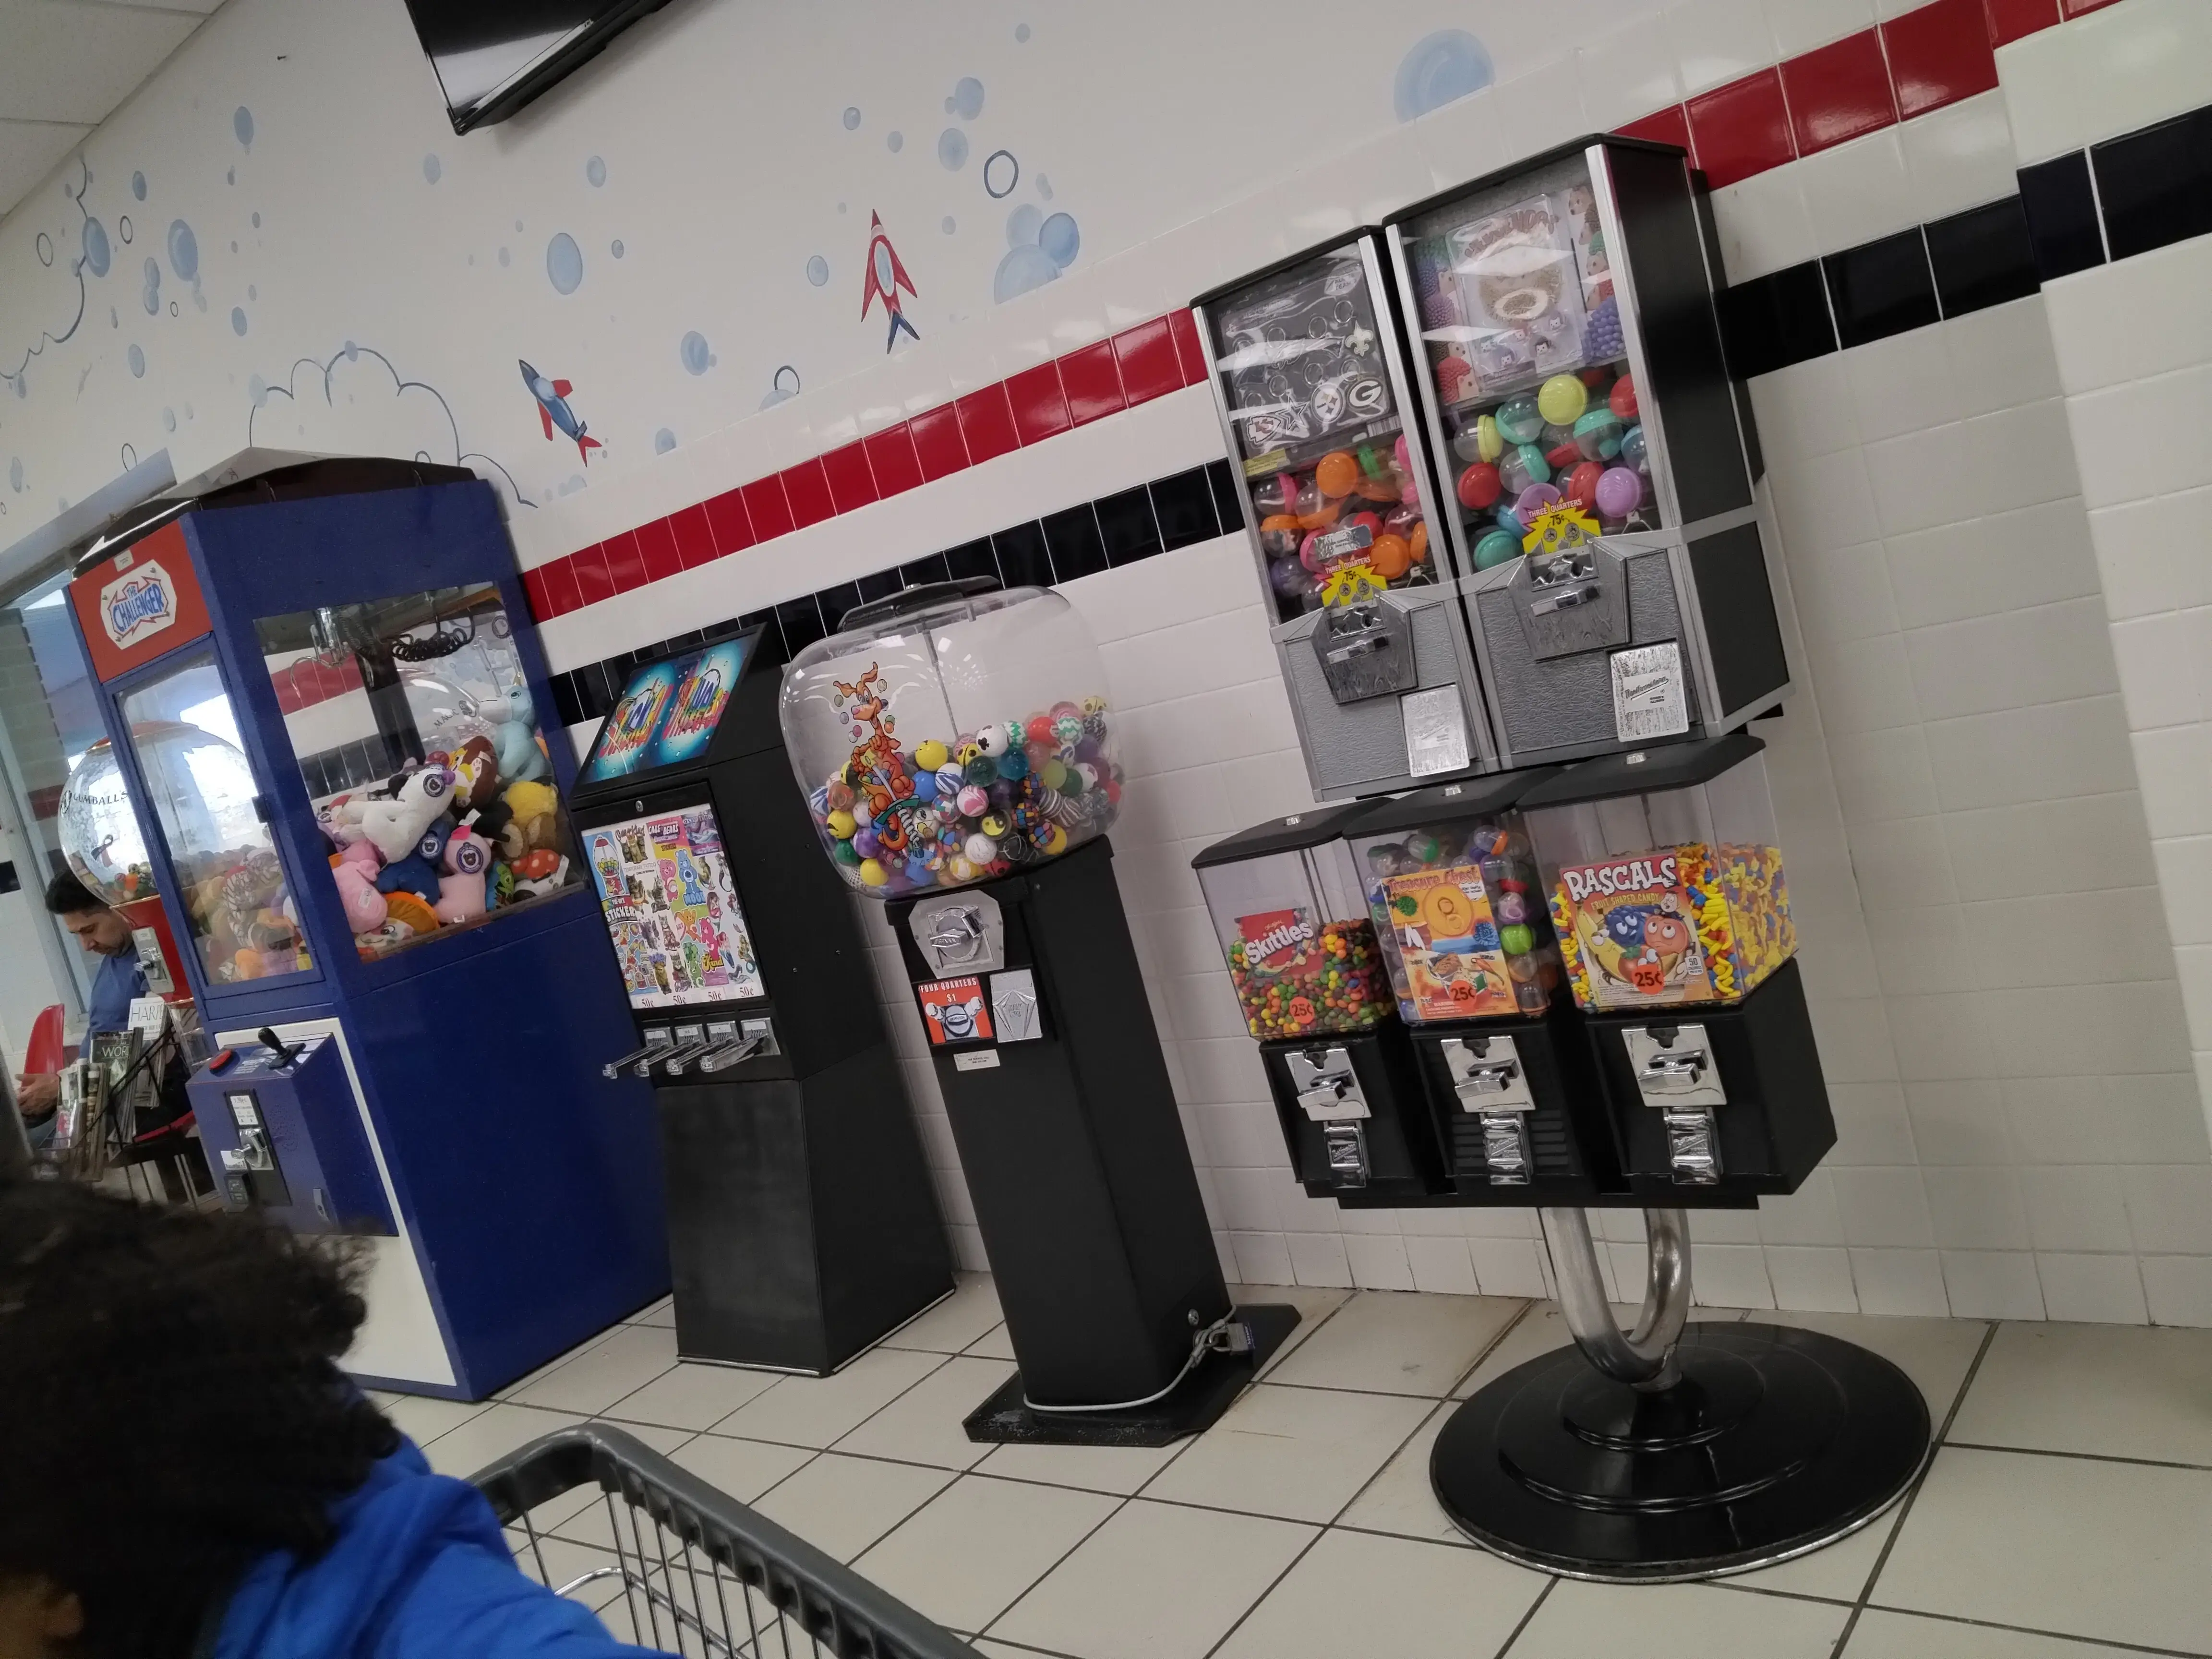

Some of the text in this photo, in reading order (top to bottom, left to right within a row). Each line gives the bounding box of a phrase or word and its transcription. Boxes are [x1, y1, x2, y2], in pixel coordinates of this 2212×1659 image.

[1528, 498, 1583, 518] THREE QUARTERS
[1550, 514, 1565, 526] 75¢
[1325, 556, 1371, 574] THREE QUARTERS
[1344, 571, 1357, 581] 75¢
[127, 586, 137, 598] THE
[113, 583, 164, 632] CHALLENGER
[73, 790, 128, 805] GUMBALLS
[648, 824, 661, 834] CARE
[663, 824, 679, 835] BEARS
[1387, 866, 1480, 894] Treasure Chest
[1563, 857, 1677, 902] RASCALS
[1590, 892, 1659, 910] FRUIT SHAPED CANDY
[605, 906, 636, 923] STICKER
[1245, 922, 1313, 964] Skittles
[920, 977, 977, 993] FOUR QUARTERS
[1635, 971, 1662, 987] 25¢
[708, 991, 722, 1001] 50¢
[740, 986, 754, 997] 50¢
[947, 993, 956, 1002] $1
[1451, 986, 1475, 1001] 25¢
[641, 998, 655, 1008] 50¢
[673, 995, 687, 1005] 50¢
[1291, 1003, 1313, 1017] 25¢
[102, 1046, 129, 1057] WOR
